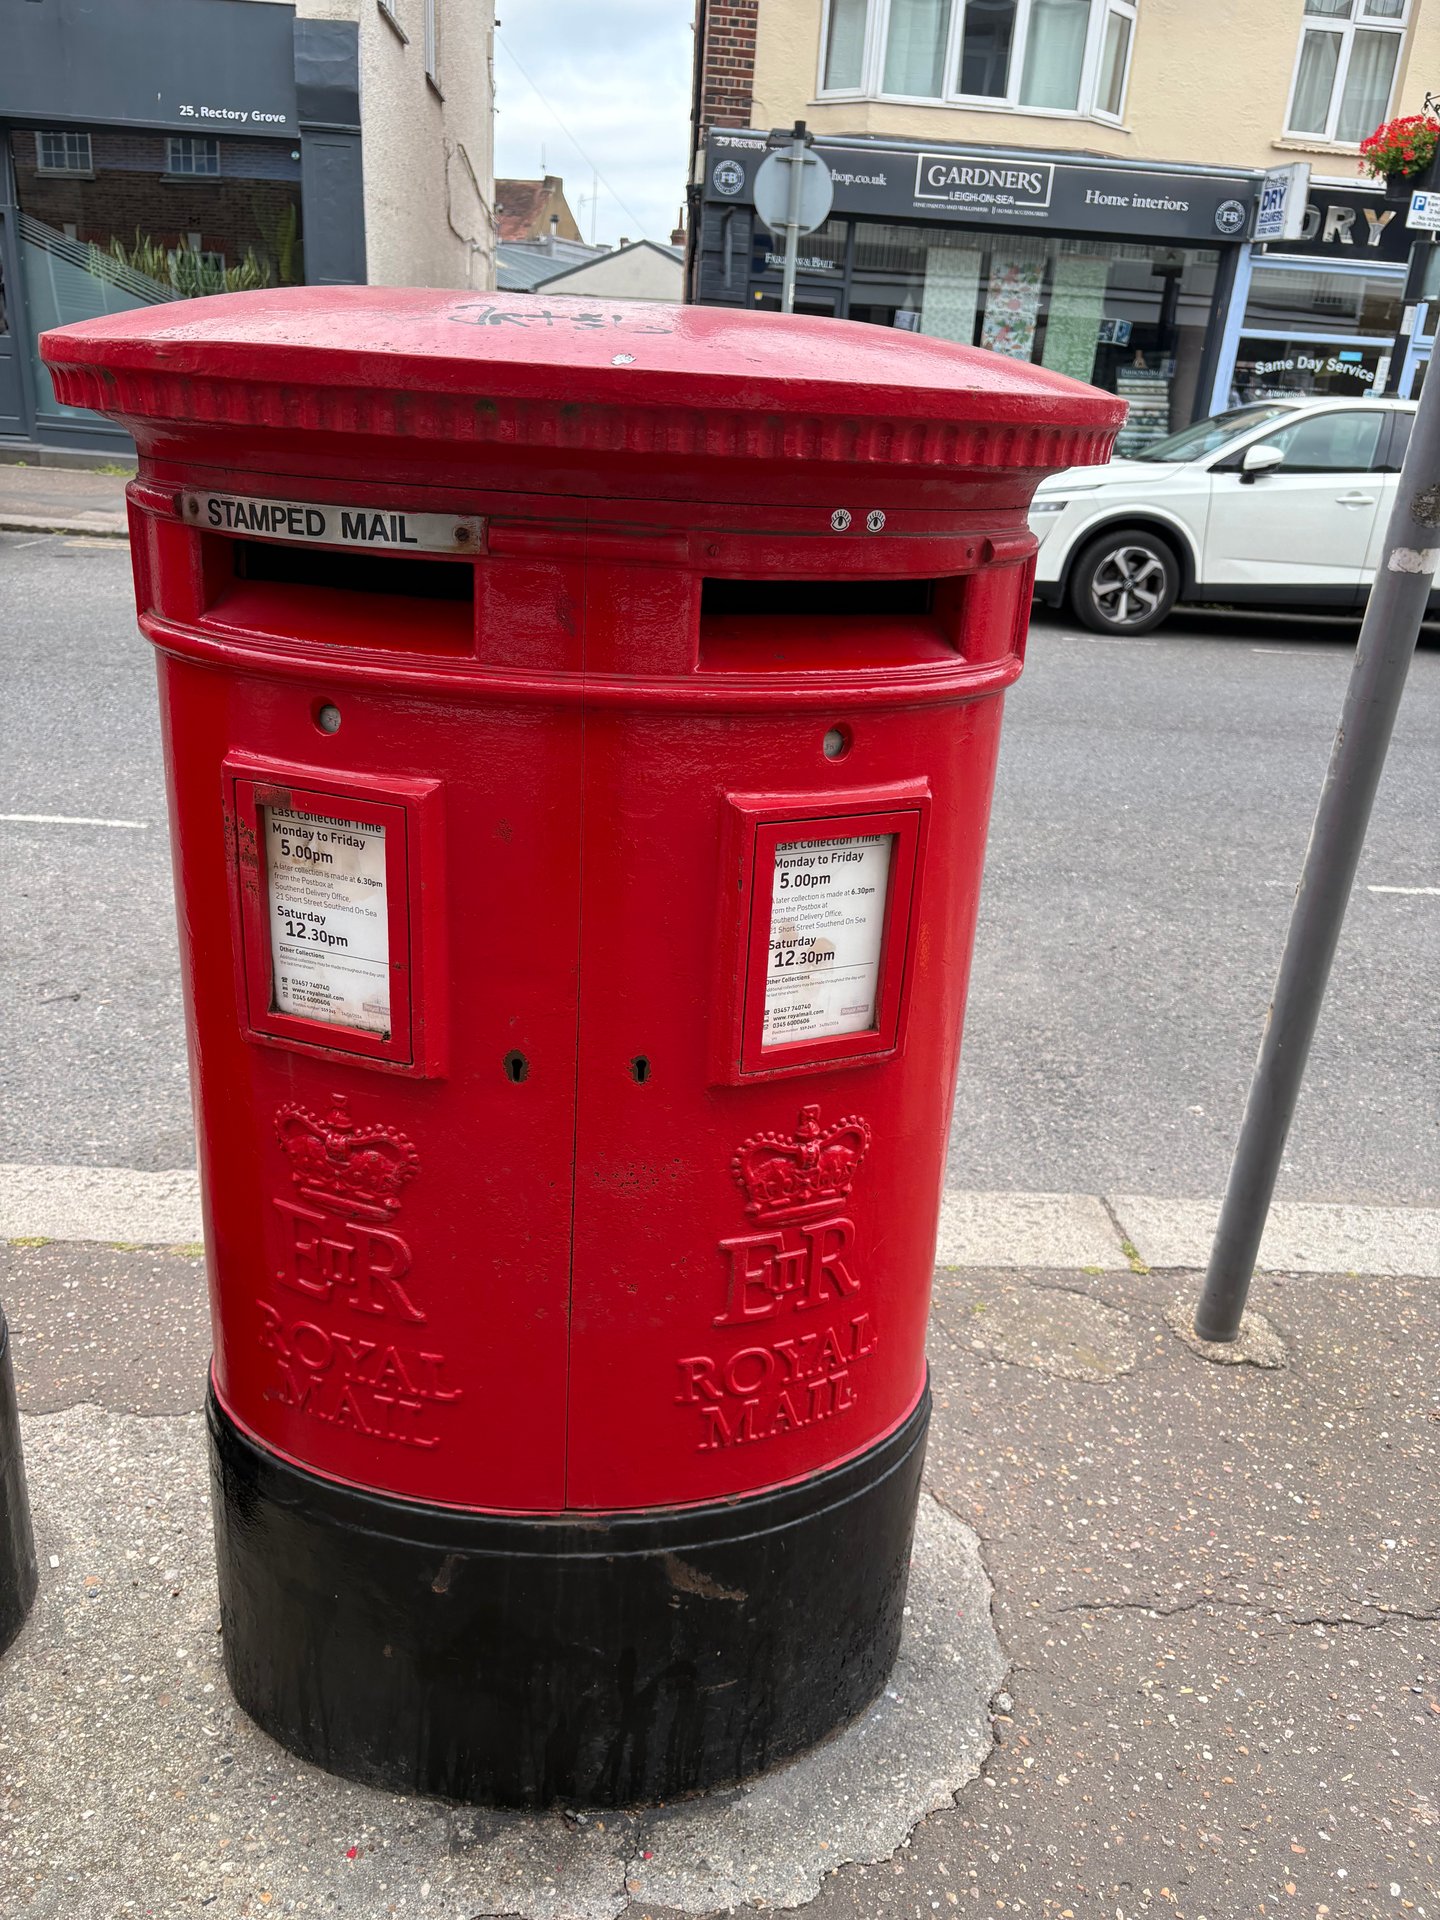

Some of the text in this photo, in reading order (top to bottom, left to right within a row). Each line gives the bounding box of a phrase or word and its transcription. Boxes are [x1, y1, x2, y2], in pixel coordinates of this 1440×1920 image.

[200, 106, 248, 122] Rectory
[251, 110, 286, 123] Grove
[830, 168, 887, 186] hop.co.uk
[927, 165, 1043, 194] GARDNERS
[950, 191, 1015, 205] LEIGH-ON-SEA
[1085, 189, 1190, 212] Home interiors
[1261, 187, 1287, 211] DRY
[1301, 204, 1396, 246] DRY
[1254, 359, 1294, 375] Same
[1296, 356, 1324, 373] Day
[1326, 358, 1375, 382] Service
[208, 499, 418, 543] STAMPED MAIL
[272, 808, 295, 818] Last
[298, 810, 351, 828] Collection
[272, 823, 366, 850] Monday to Friday
[775, 842, 798, 852] Last
[800, 837, 852, 849] Collection
[281, 840, 333, 864] 5.00pm
[775, 852, 864, 869] Monday to Friday
[274, 872, 334, 889] from the Postbox at
[280, 863, 294, 872] later
[294, 866, 324, 877] collection
[330, 872, 347, 882] made
[347, 875, 356, 883] at
[357, 875, 383, 888] 6.30pm
[780, 872, 831, 889] 5.00pm
[275, 882, 305, 895] Southend
[305, 887, 331, 900] Delivery
[775, 896, 790, 904] later
[791, 892, 820, 903] collection
[826, 890, 843, 898] made
[851, 887, 875, 896] 6.30pm
[276, 892, 377, 918] 21 Short Street Southend On Sea
[772, 907, 785, 915] rom
[786, 905, 796, 913] the
[797, 902, 821, 911] Postbox
[277, 905, 326, 925] Saturday
[800, 911, 823, 923] Delivery
[285, 920, 348, 947] 12.30pm
[778, 925, 795, 934] Short
[796, 923, 815, 932] Street
[815, 919, 844, 929] Southend
[845, 917, 854, 925] On
[855, 916, 867, 924] Sea
[769, 936, 816, 950] Saturday
[280, 945, 325, 960] Other Collections
[774, 950, 835, 968] 12.30pm
[291, 978, 330, 991] 03457 740740
[766, 975, 810, 986] Other Collections
[292, 986, 345, 1002] www.royalmail.com
[292, 993, 307, 1002] 0345
[772, 1009, 825, 1022] www.royalmail.com
[773, 1003, 811, 1014] 03457 740740
[772, 1021, 787, 1029] 0345
[787, 1018, 810, 1028] 6000606
[255, 1299, 463, 1399] ROYAL
[674, 1312, 878, 1403] ROYAL
[263, 1359, 441, 1448] MAIL
[698, 1369, 858, 1448] MAIL
